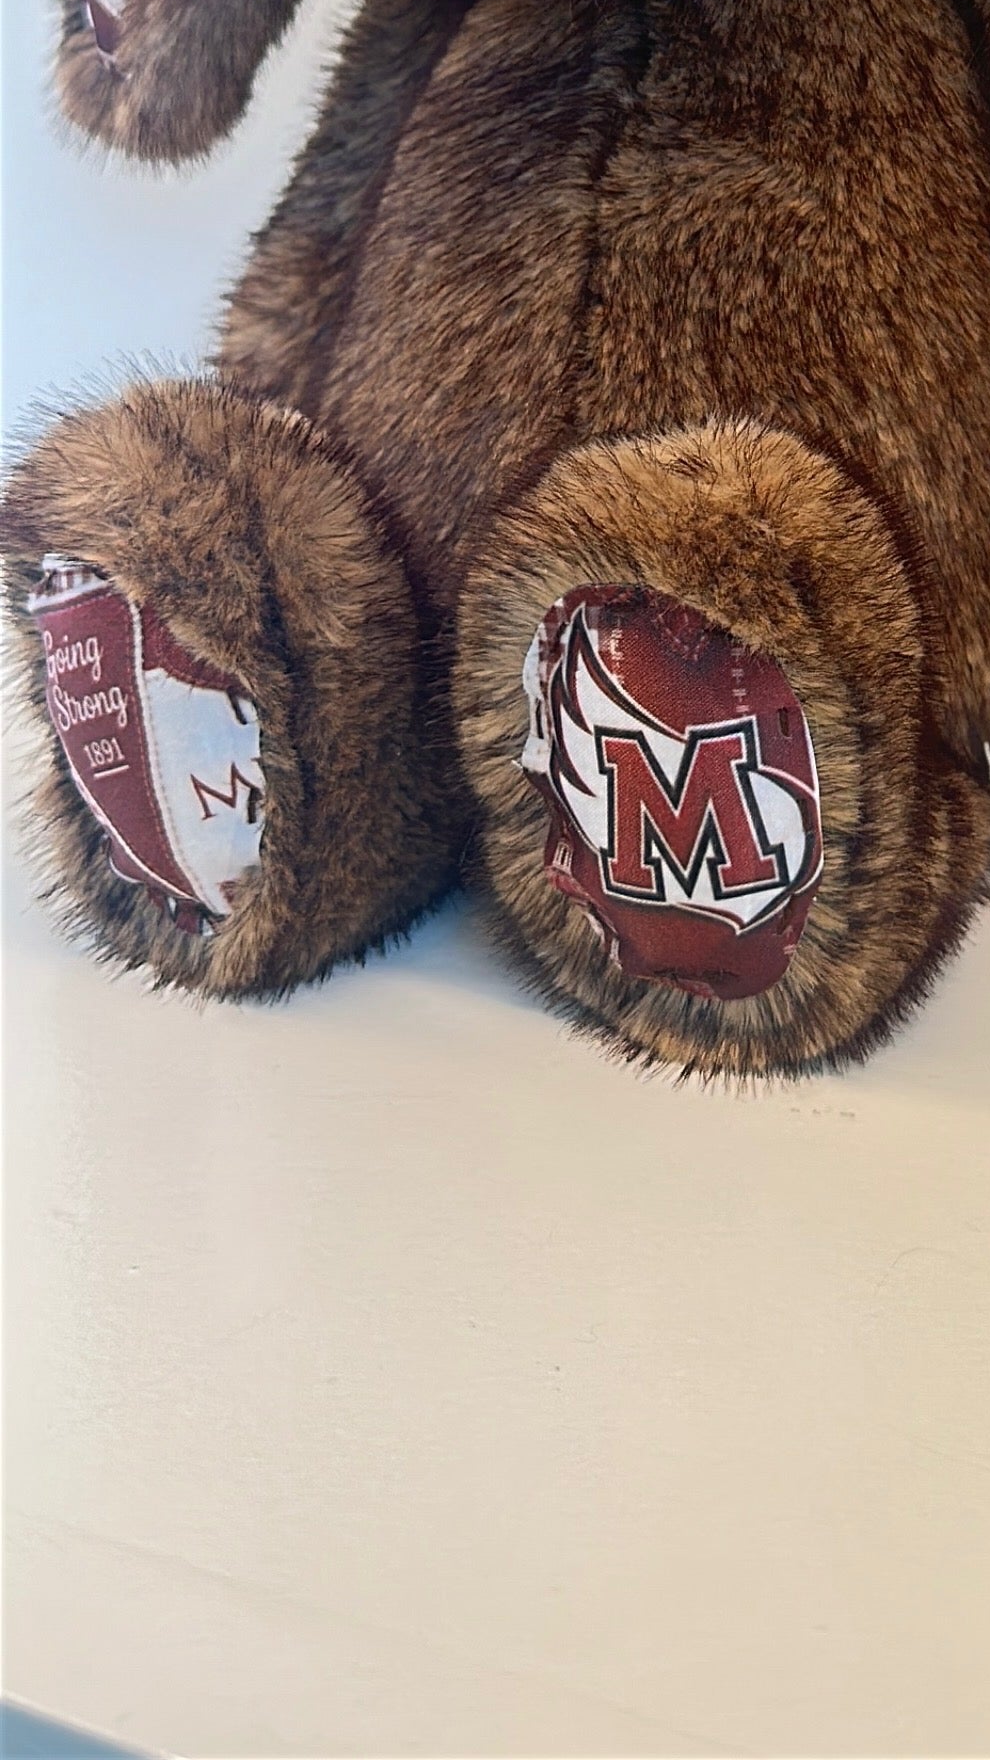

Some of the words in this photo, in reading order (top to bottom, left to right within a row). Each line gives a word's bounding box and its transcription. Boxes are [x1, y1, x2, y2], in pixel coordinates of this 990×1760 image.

[43, 630, 104, 683] Going
[52, 686, 128, 728] Strong
[83, 737, 125, 767] 1891
[593, 715, 791, 902] M
